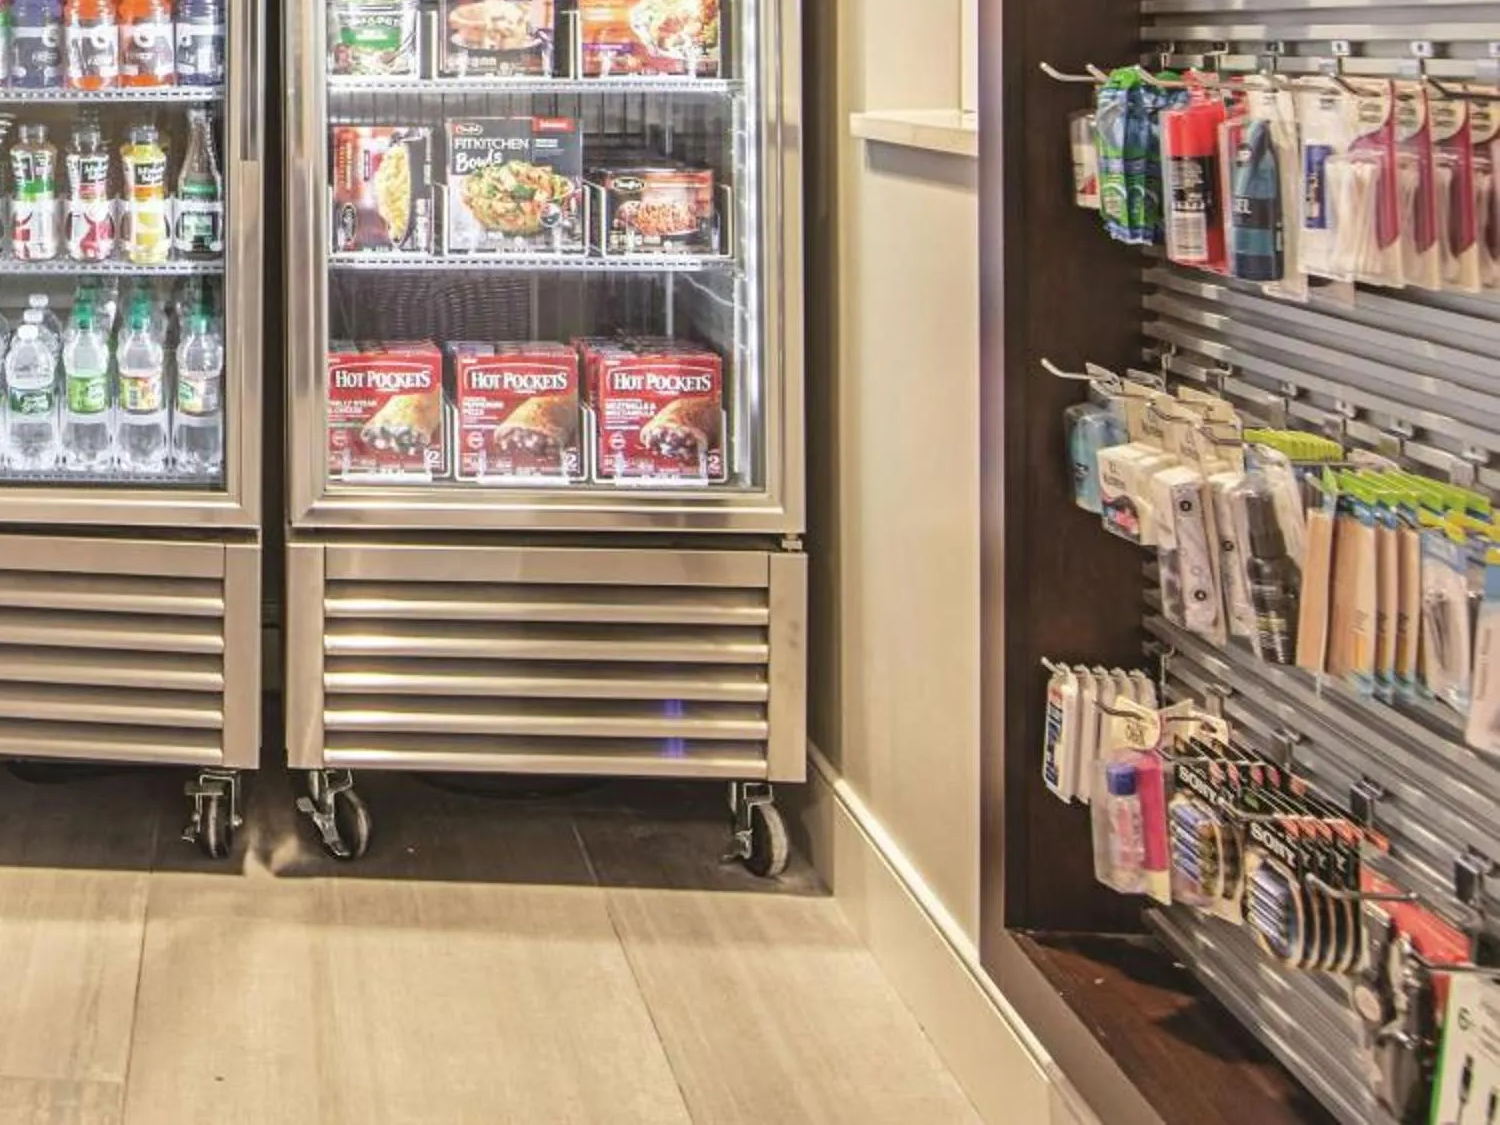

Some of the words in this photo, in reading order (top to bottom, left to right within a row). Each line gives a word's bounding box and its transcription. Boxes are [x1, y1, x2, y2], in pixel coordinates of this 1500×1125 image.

[456, 148, 503, 173] Bowls
[335, 370, 364, 388] HOT
[366, 369, 431, 390] POCKETS
[471, 372, 501, 389] HOT
[503, 371, 568, 391] POCKETS
[614, 373, 644, 390] HOT
[646, 373, 711, 392] POCKETS
[1178, 764, 1219, 804] SONY
[1250, 821, 1297, 869] SONY
